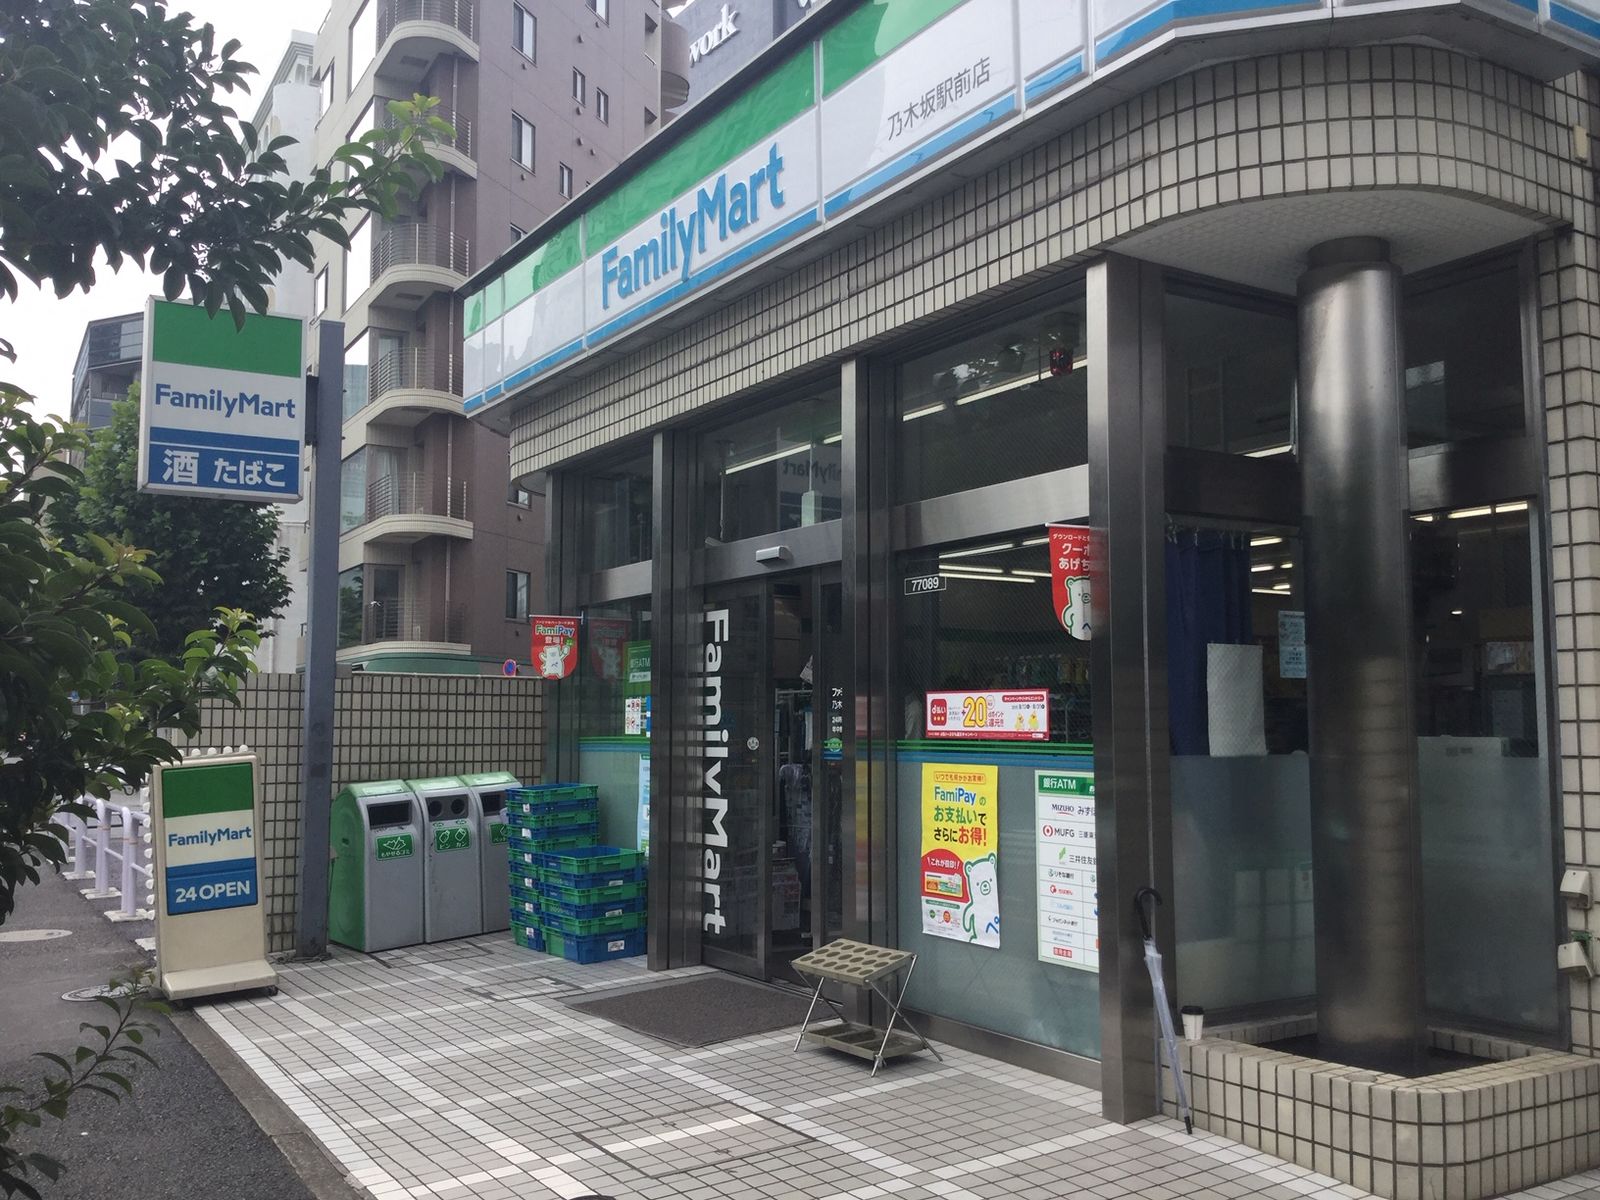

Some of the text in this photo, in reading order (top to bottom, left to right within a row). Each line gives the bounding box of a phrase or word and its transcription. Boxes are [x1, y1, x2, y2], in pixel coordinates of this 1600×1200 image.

[887, 56, 991, 142] 乃木坂駅前店
[602, 142, 786, 310] FamilyMart
[155, 383, 296, 420] FamilyMart
[162, 449, 286, 488] 酒 たばこ
[911, 576, 940, 592] 77089
[535, 625, 575, 637] FamiPay
[1043, 777, 1076, 790] 銀行ATM
[933, 805, 988, 826] お支払いで
[1051, 803, 1075, 813] MIZUHO
[168, 825, 252, 848] FamilyMart
[933, 826, 988, 847] さらにお得!
[1054, 827, 1075, 838] MUFG
